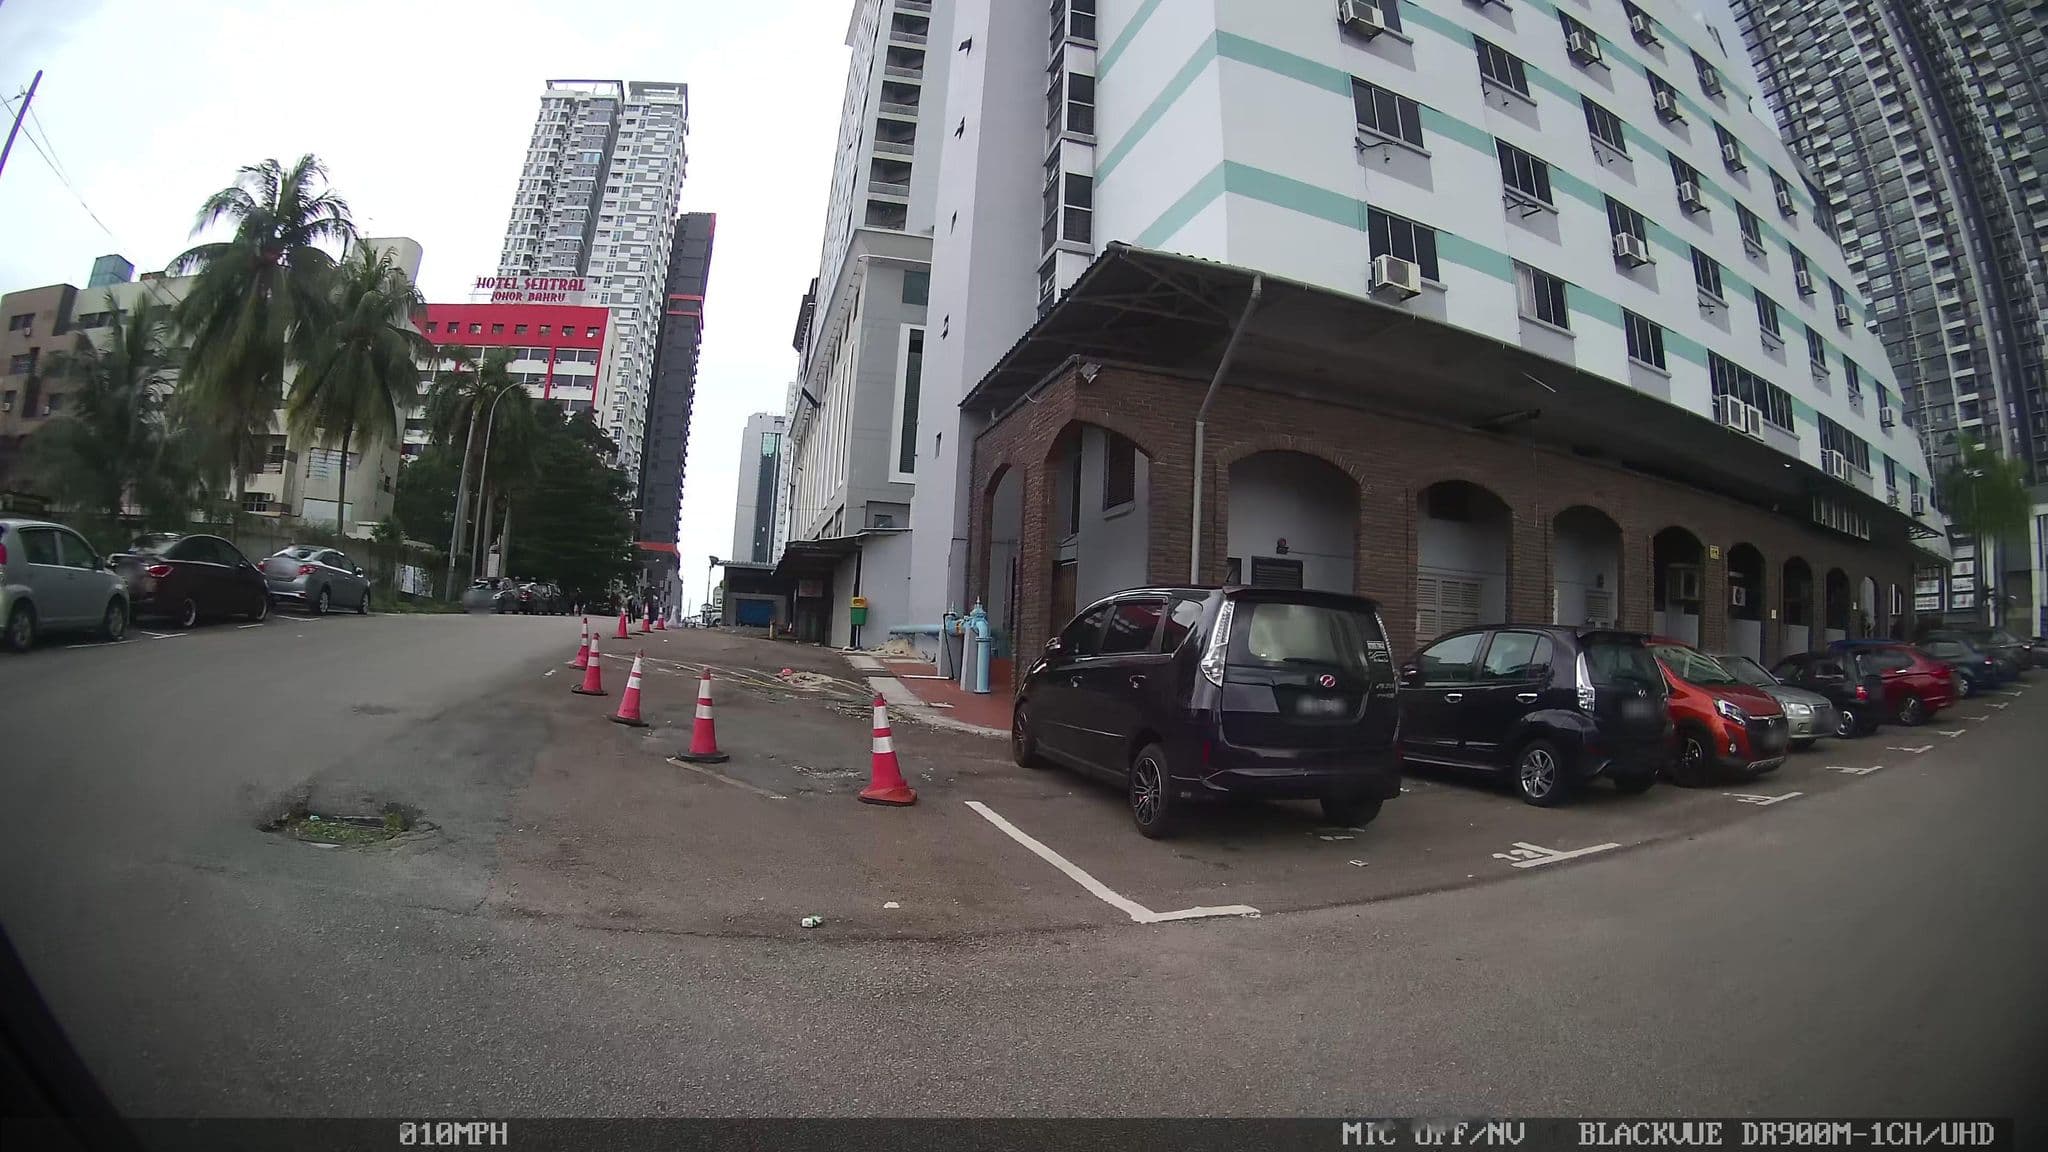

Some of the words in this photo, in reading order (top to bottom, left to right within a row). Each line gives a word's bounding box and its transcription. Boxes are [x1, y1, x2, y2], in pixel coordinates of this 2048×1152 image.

[476, 277, 519, 290] HOTEL
[524, 279, 586, 292] SENTRAL
[491, 291, 523, 302] JOHOR
[527, 292, 566, 302] BAHRU
